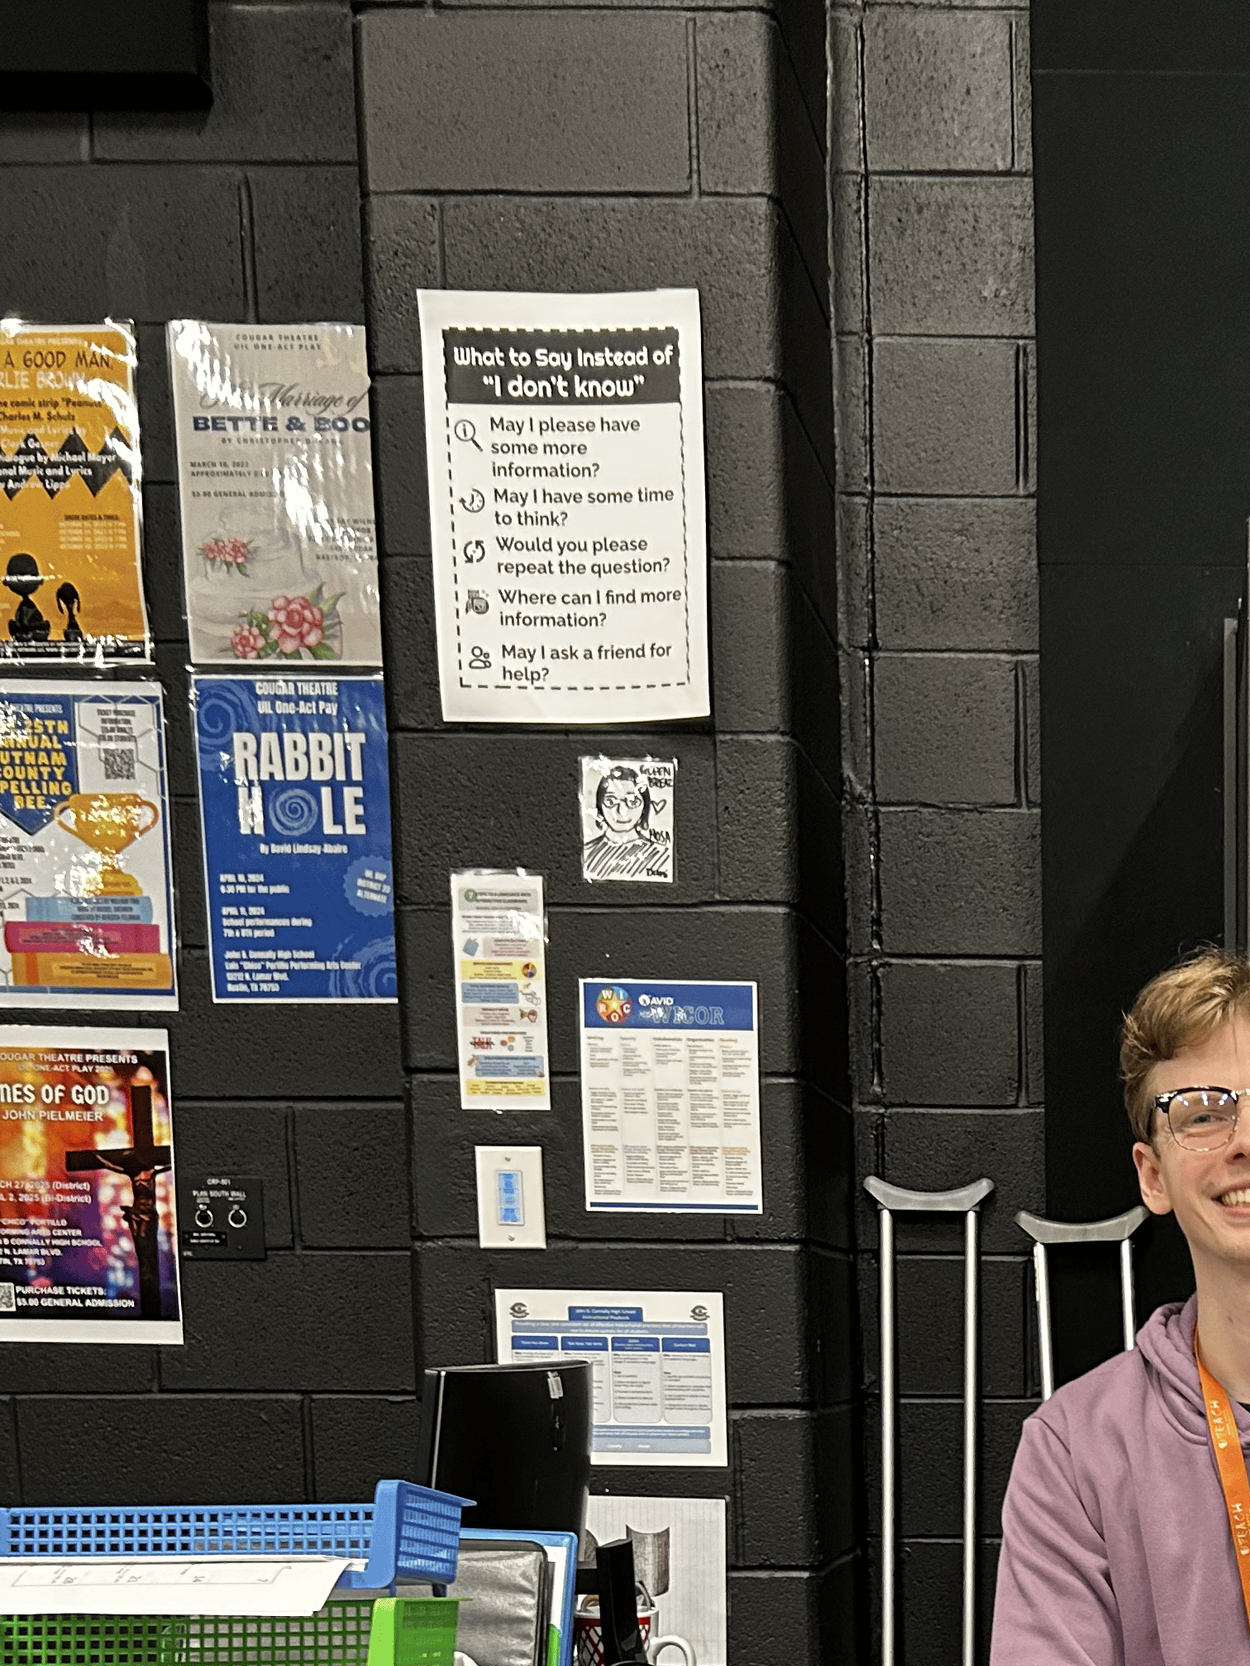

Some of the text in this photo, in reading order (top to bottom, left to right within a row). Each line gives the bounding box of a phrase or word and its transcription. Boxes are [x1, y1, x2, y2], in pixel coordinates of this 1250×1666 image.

[235, 334, 319, 342] COUGAR THEATRE
[4, 350, 15, 368] A
[23, 351, 67, 369] GOOD
[453, 345, 673, 371] What to Say Instead of
[508, 376, 568, 398] don't
[574, 375, 645, 397] know”
[33, 412, 44, 421] M.
[192, 415, 371, 433] BETTE & BOO
[490, 416, 641, 437] May I please have
[491, 443, 588, 455] some more
[492, 462, 600, 479] information?
[494, 487, 675, 506] May I have some time
[494, 511, 568, 526] to think?
[496, 537, 649, 557] Would you please
[497, 559, 671, 580] repeat the question?
[499, 589, 682, 606] Where can I find more
[500, 614, 607, 632] information?
[502, 643, 672, 664] May I ask a friend for
[502, 666, 549, 686] help?
[255, 682, 338, 696] COUGAR THEATRE
[257, 700, 338, 716] UIL One-Act Pay
[232, 731, 366, 782] RABBIT
[650, 996, 674, 1006] AVID
[39, 1053, 84, 1063] THEATRE
[85, 1054, 139, 1064] PRESENTS
[72, 1064, 95, 1073] PLAY
[41, 1084, 66, 1104] OF
[71, 1084, 110, 1106] GOD
[2, 1109, 104, 1122] JOHN PIELMEIER
[52, 1181, 91, 1192] (District)
[52, 1228, 82, 1237] CENTER
[15, 1286, 107, 1296] PURCHASE TICKETS:
[41, 1297, 83, 1308] GENERAL
[85, 1298, 135, 1308] ADMISSION
